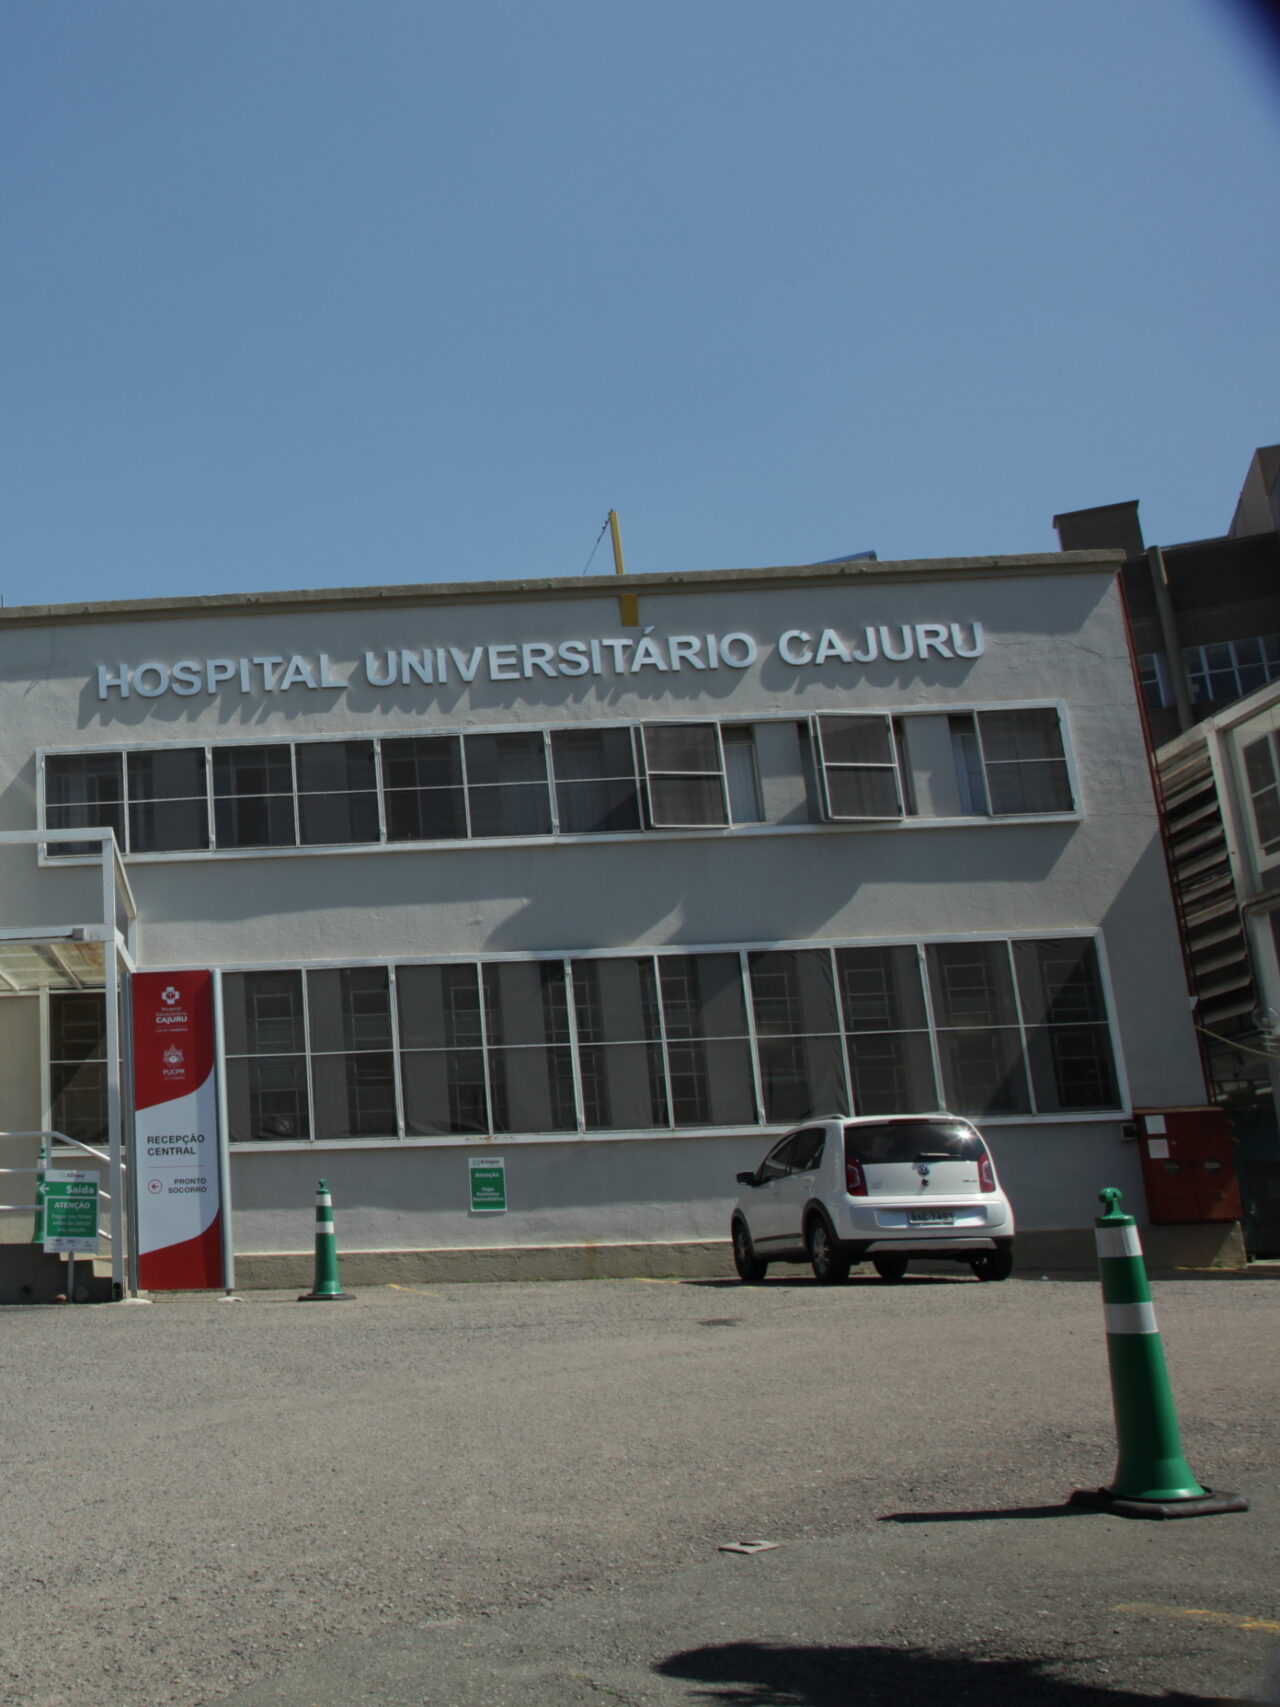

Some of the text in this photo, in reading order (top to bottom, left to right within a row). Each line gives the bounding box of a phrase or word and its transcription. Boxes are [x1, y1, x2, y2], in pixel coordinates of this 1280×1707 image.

[97, 621, 985, 700] HOSPITAL UNIVERSITÁRIO CAJURU
[147, 1132, 205, 1145] RECEPÇÃO
[147, 1147, 197, 1156] CENTRAL
[66, 1184, 95, 1194] Saída
[168, 1186, 207, 1194] SOCORRO
[54, 1201, 91, 1210] ATENÇÃO
